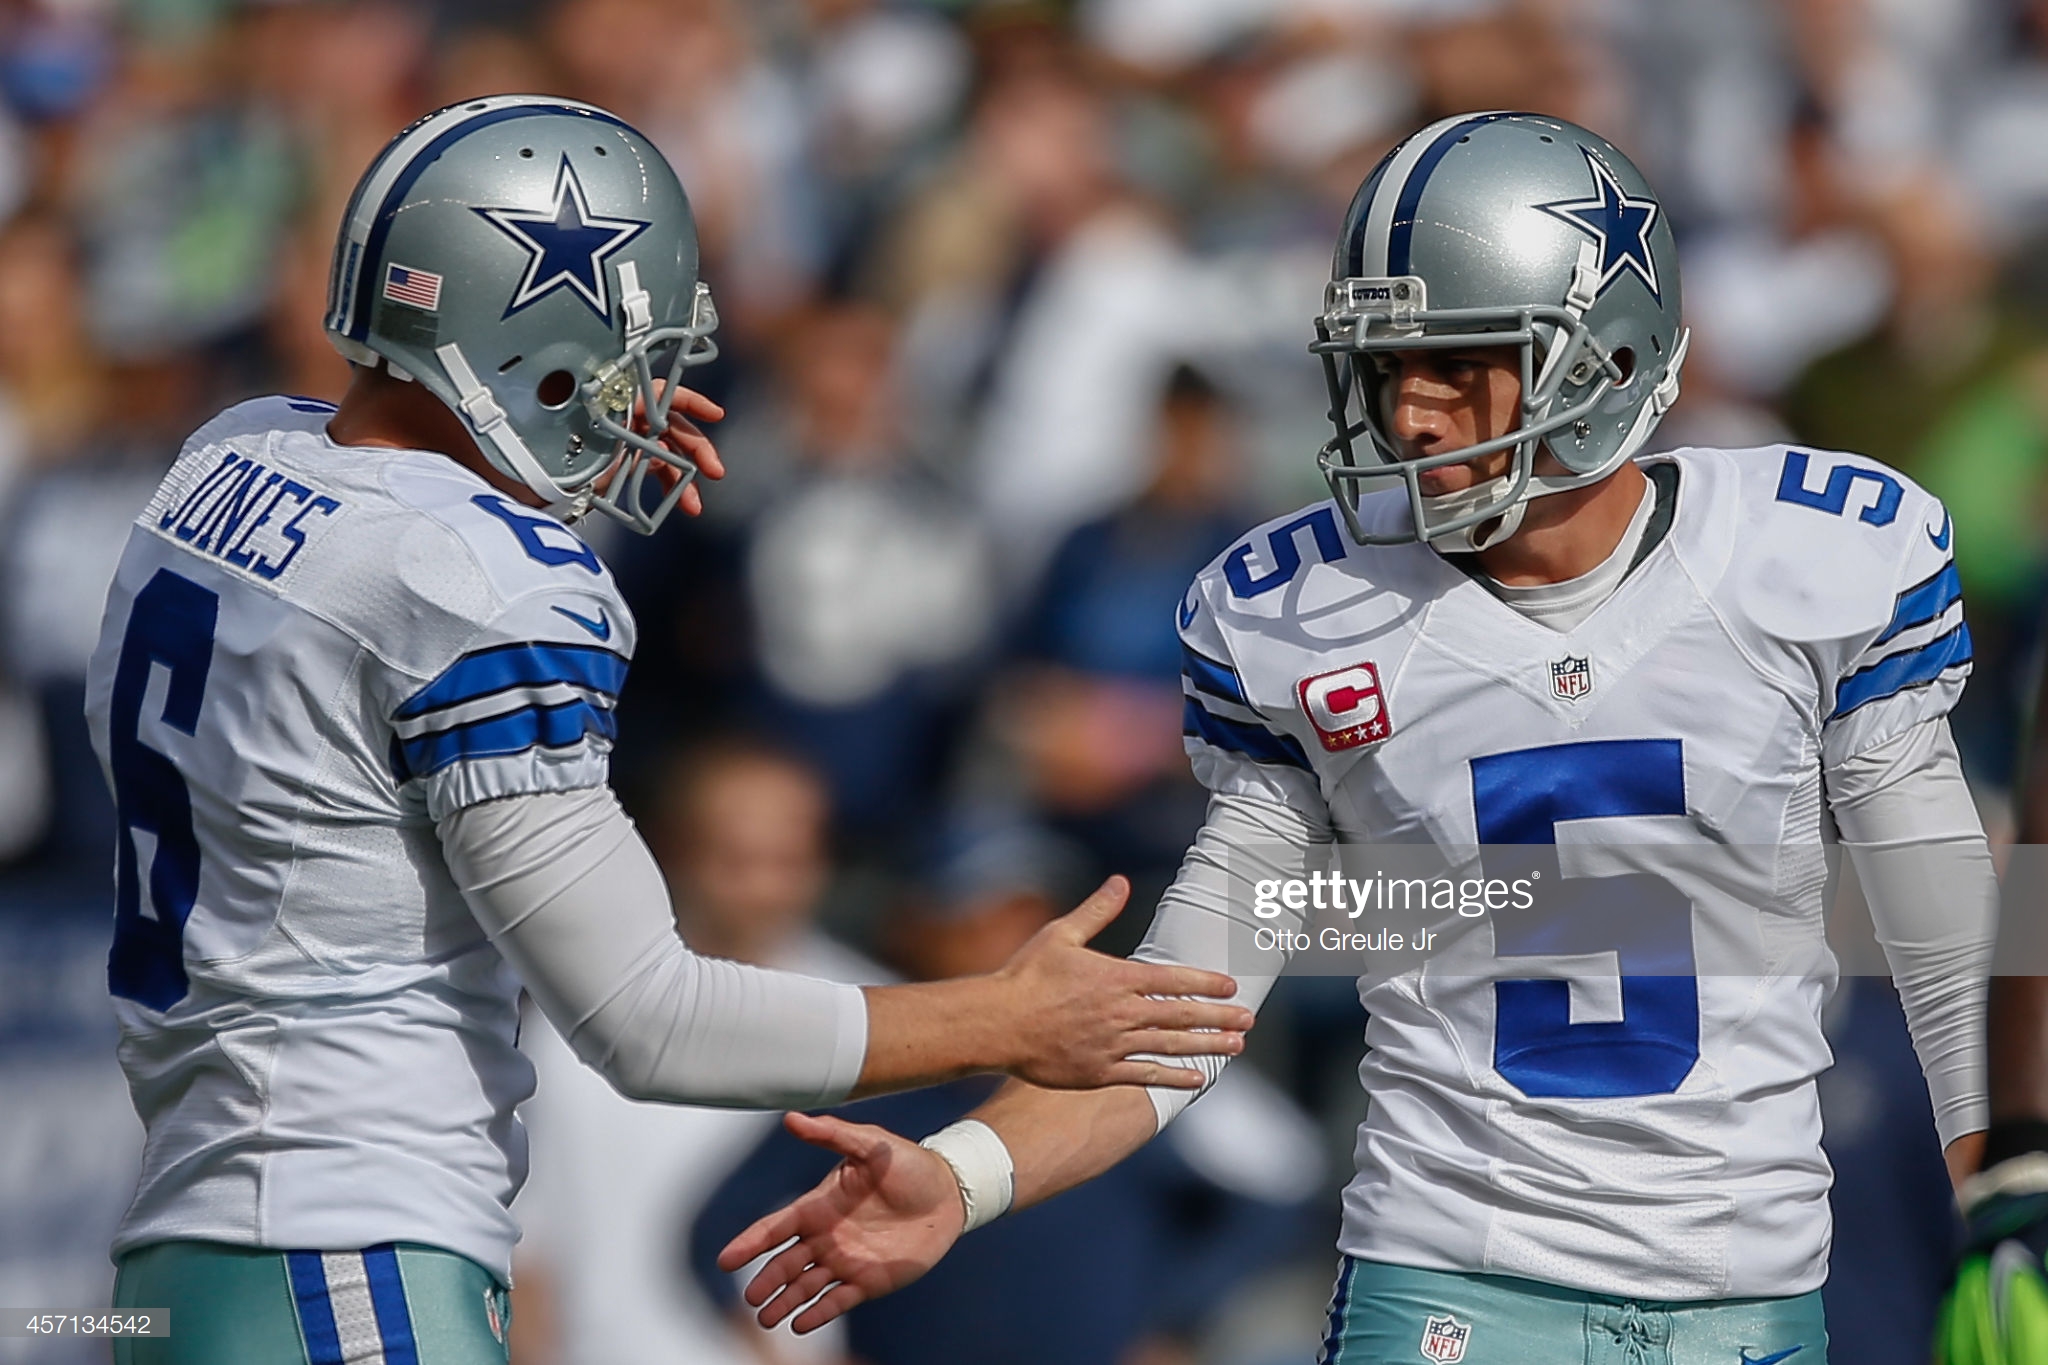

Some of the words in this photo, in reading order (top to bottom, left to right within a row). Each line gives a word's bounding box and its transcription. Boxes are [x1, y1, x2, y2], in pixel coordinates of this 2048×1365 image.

[159, 451, 342, 580] JONES
[1775, 450, 1905, 528] 5
[471, 494, 603, 576] 6
[1222, 507, 1348, 600] 5
[1305, 667, 1380, 732] C
[1556, 673, 1588, 696] NFL
[108, 566, 220, 1014] 6
[1468, 738, 1701, 1099] 5
[1427, 1335, 1458, 1358] NFL
